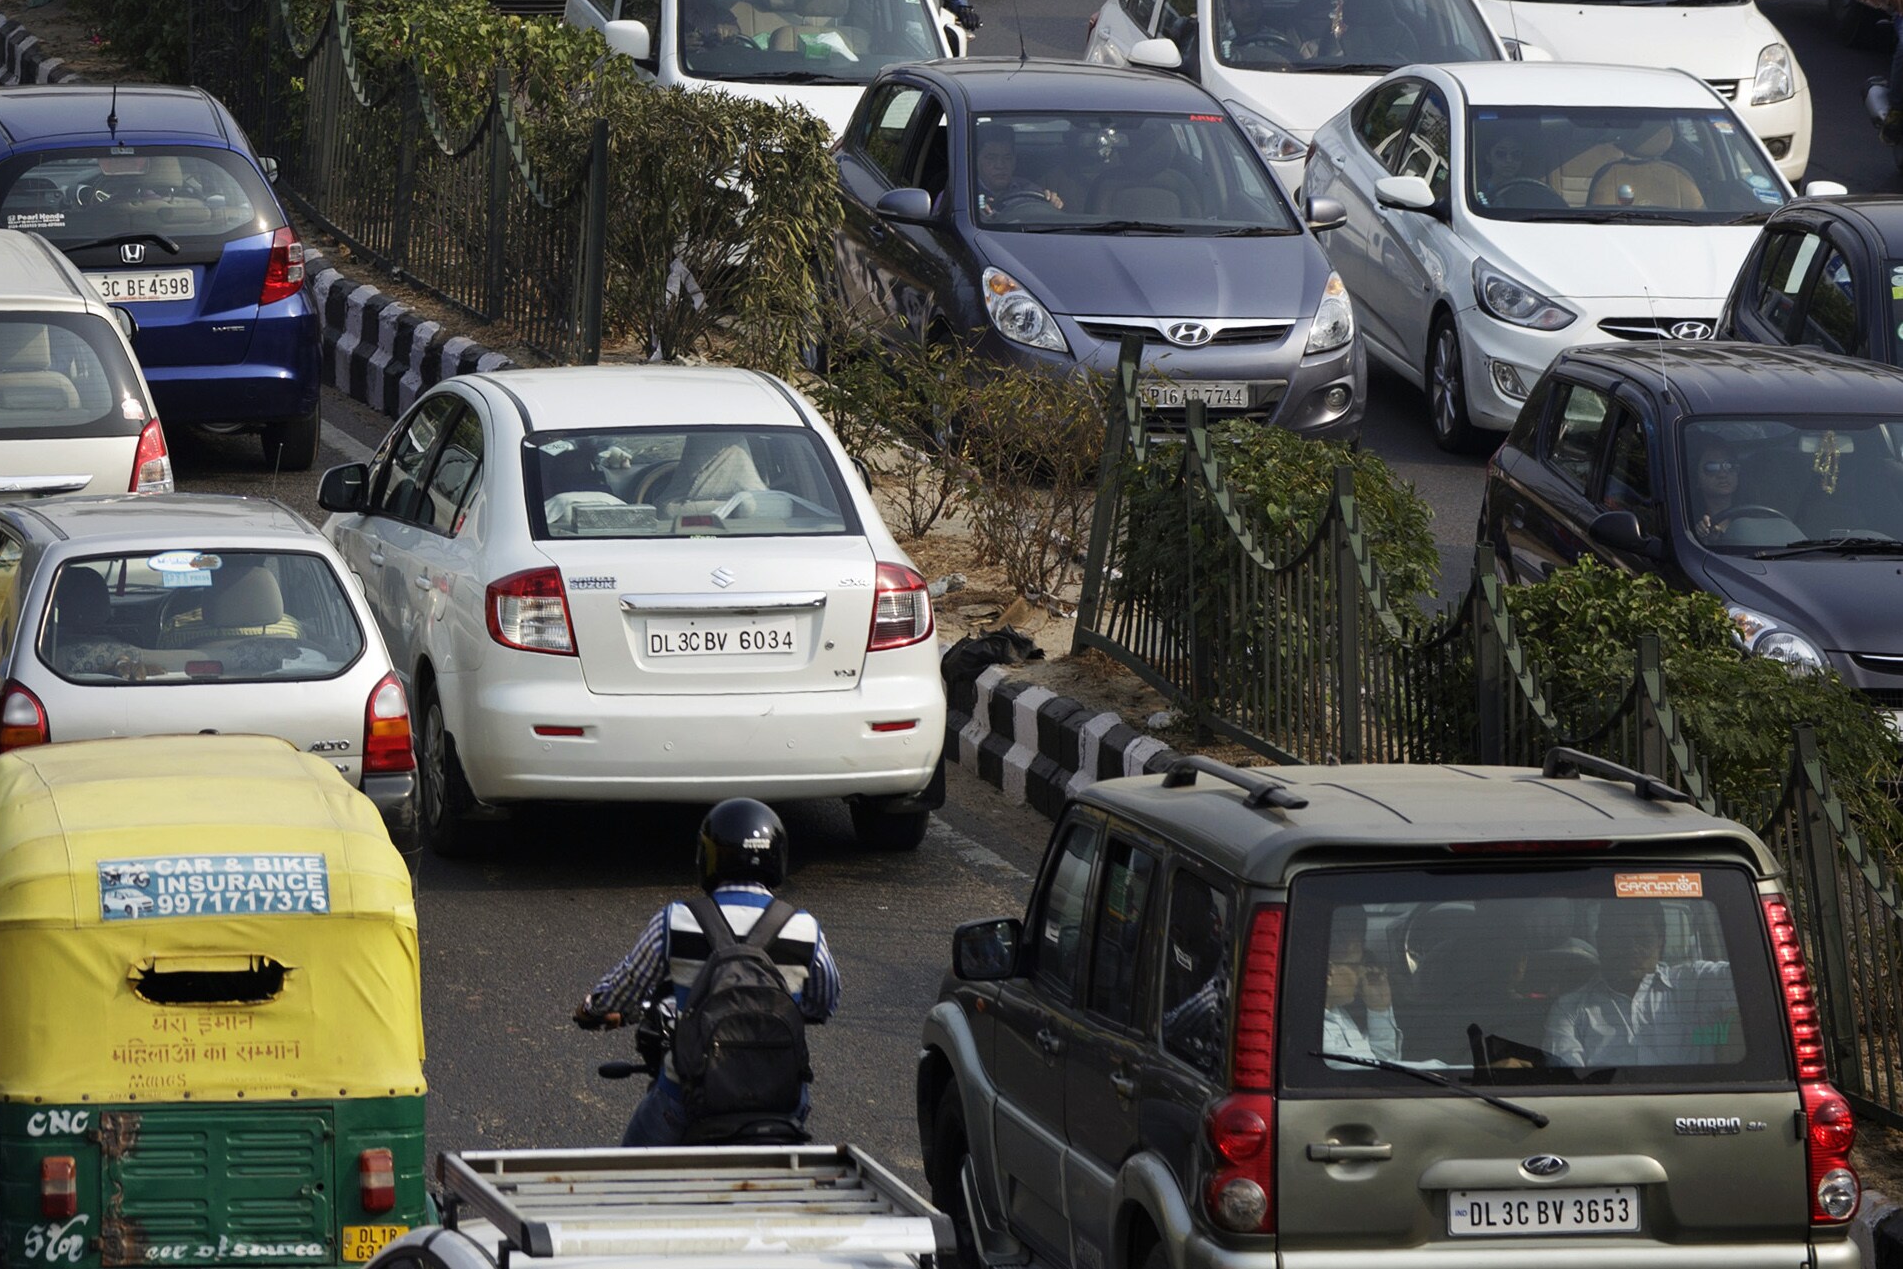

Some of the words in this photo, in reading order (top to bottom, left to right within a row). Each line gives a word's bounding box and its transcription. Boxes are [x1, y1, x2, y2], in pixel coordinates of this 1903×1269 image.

[17, 213, 39, 221] Pearl
[39, 212, 65, 220] Honda
[1204, 380, 1244, 407] 7744
[569, 582, 616, 590] SUZUKI
[739, 631, 794, 652] 6034
[311, 740, 350, 751] ALTO
[153, 859, 212, 874] CAR
[222, 859, 240, 873] &
[250, 857, 319, 873] BIKE
[157, 875, 323, 893] INSURANCE
[157, 891, 328, 915] 9971717375
[204, 1041, 226, 1061] का
[1675, 1117, 1741, 1135] SCORPIO
[1470, 1202, 1498, 1227] DL
[1502, 1201, 1530, 1226] 3C
[1537, 1200, 1565, 1225] BV
[1572, 1198, 1630, 1224] 3653
